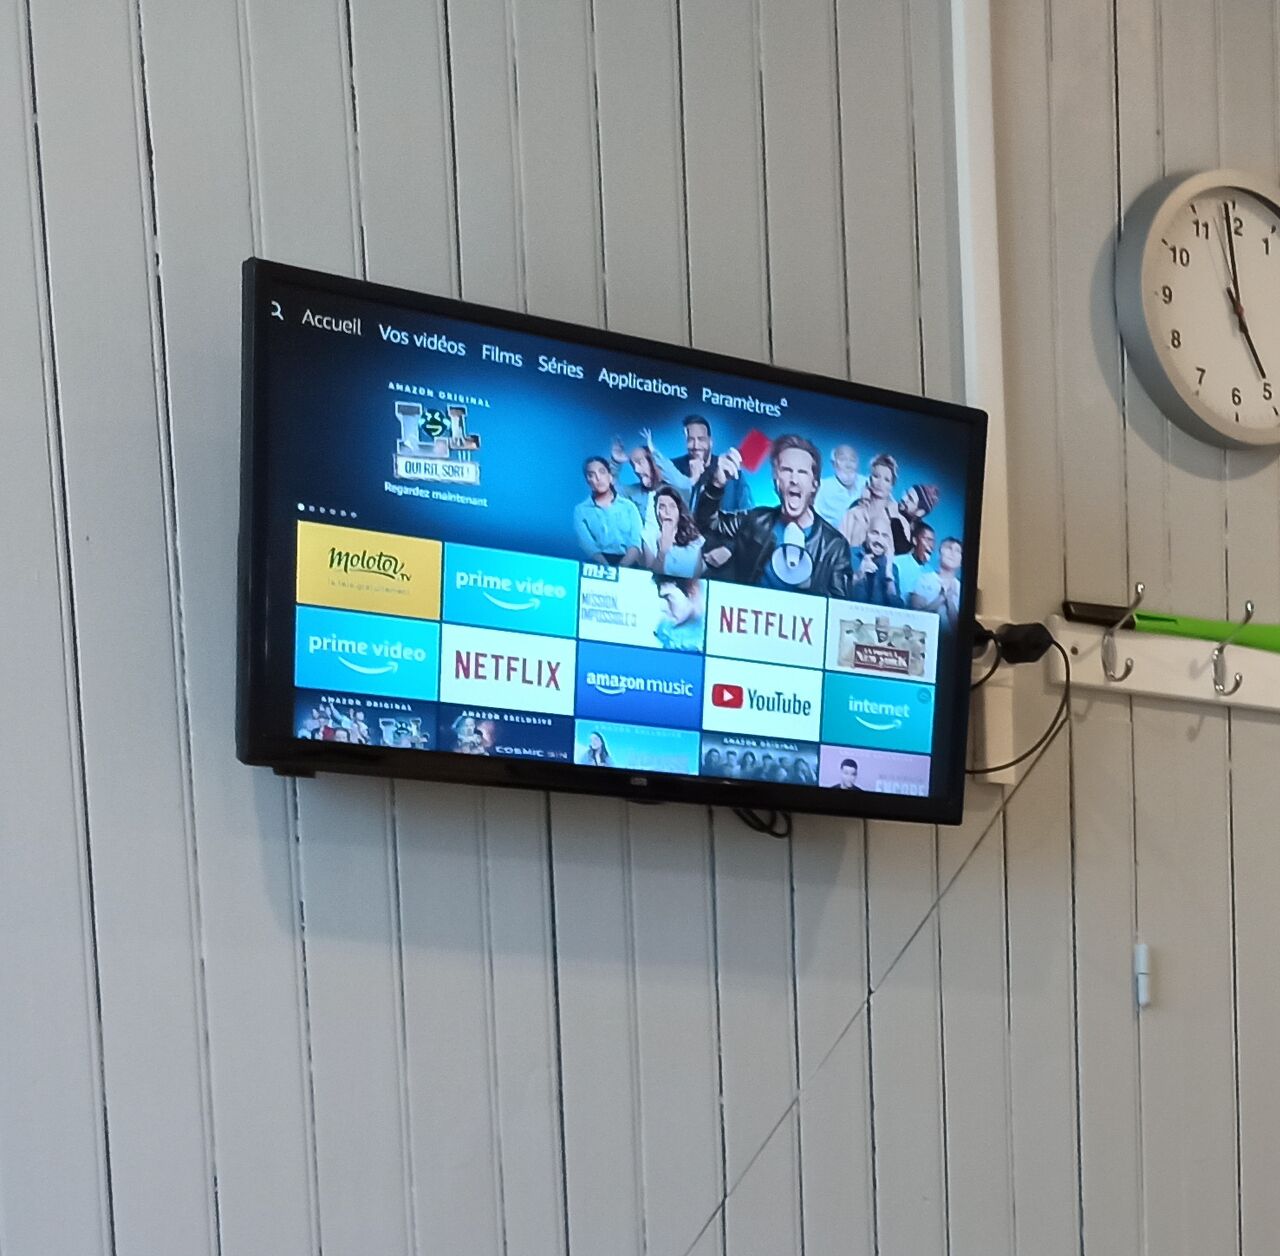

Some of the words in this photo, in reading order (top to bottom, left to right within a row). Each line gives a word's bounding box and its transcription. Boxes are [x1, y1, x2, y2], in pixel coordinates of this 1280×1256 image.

[1192, 219, 1209, 240] 11
[1170, 245, 1190, 267] 10
[1262, 237, 1270, 255] 1
[1162, 285, 1172, 305] 9
[1171, 329, 1181, 349] 8
[301, 309, 362, 335] Accueil
[378, 324, 409, 345] Vos
[413, 331, 466, 356] vidéos
[481, 343, 523, 367] Films
[537, 355, 584, 379] Séries
[598, 367, 689, 399] Applications
[701, 387, 781, 417] Paramètres
[1195, 367, 1206, 385] 7
[388, 382, 434, 397] AMAZON
[438, 390, 491, 408] ORIGINAL
[1231, 387, 1241, 406] 6
[1262, 382, 1272, 401] 5
[404, 460, 421, 475] QUI
[384, 481, 430, 499] Regardez
[431, 490, 488, 508] maintenant
[329, 547, 404, 577] Molotov
[456, 570, 512, 591] prime
[515, 577, 567, 599] video
[720, 605, 813, 645] NETFLIX
[309, 633, 368, 655] prime
[372, 640, 426, 662] video
[455, 650, 561, 691] NETFLIX
[586, 672, 644, 691] amazon
[647, 679, 694, 697] music
[321, 696, 362, 708] AMAZON
[366, 700, 413, 712] ORIGINAL
[747, 688, 812, 716] YouTube
[848, 695, 910, 718] internet
[462, 710, 500, 721] AMAZON
